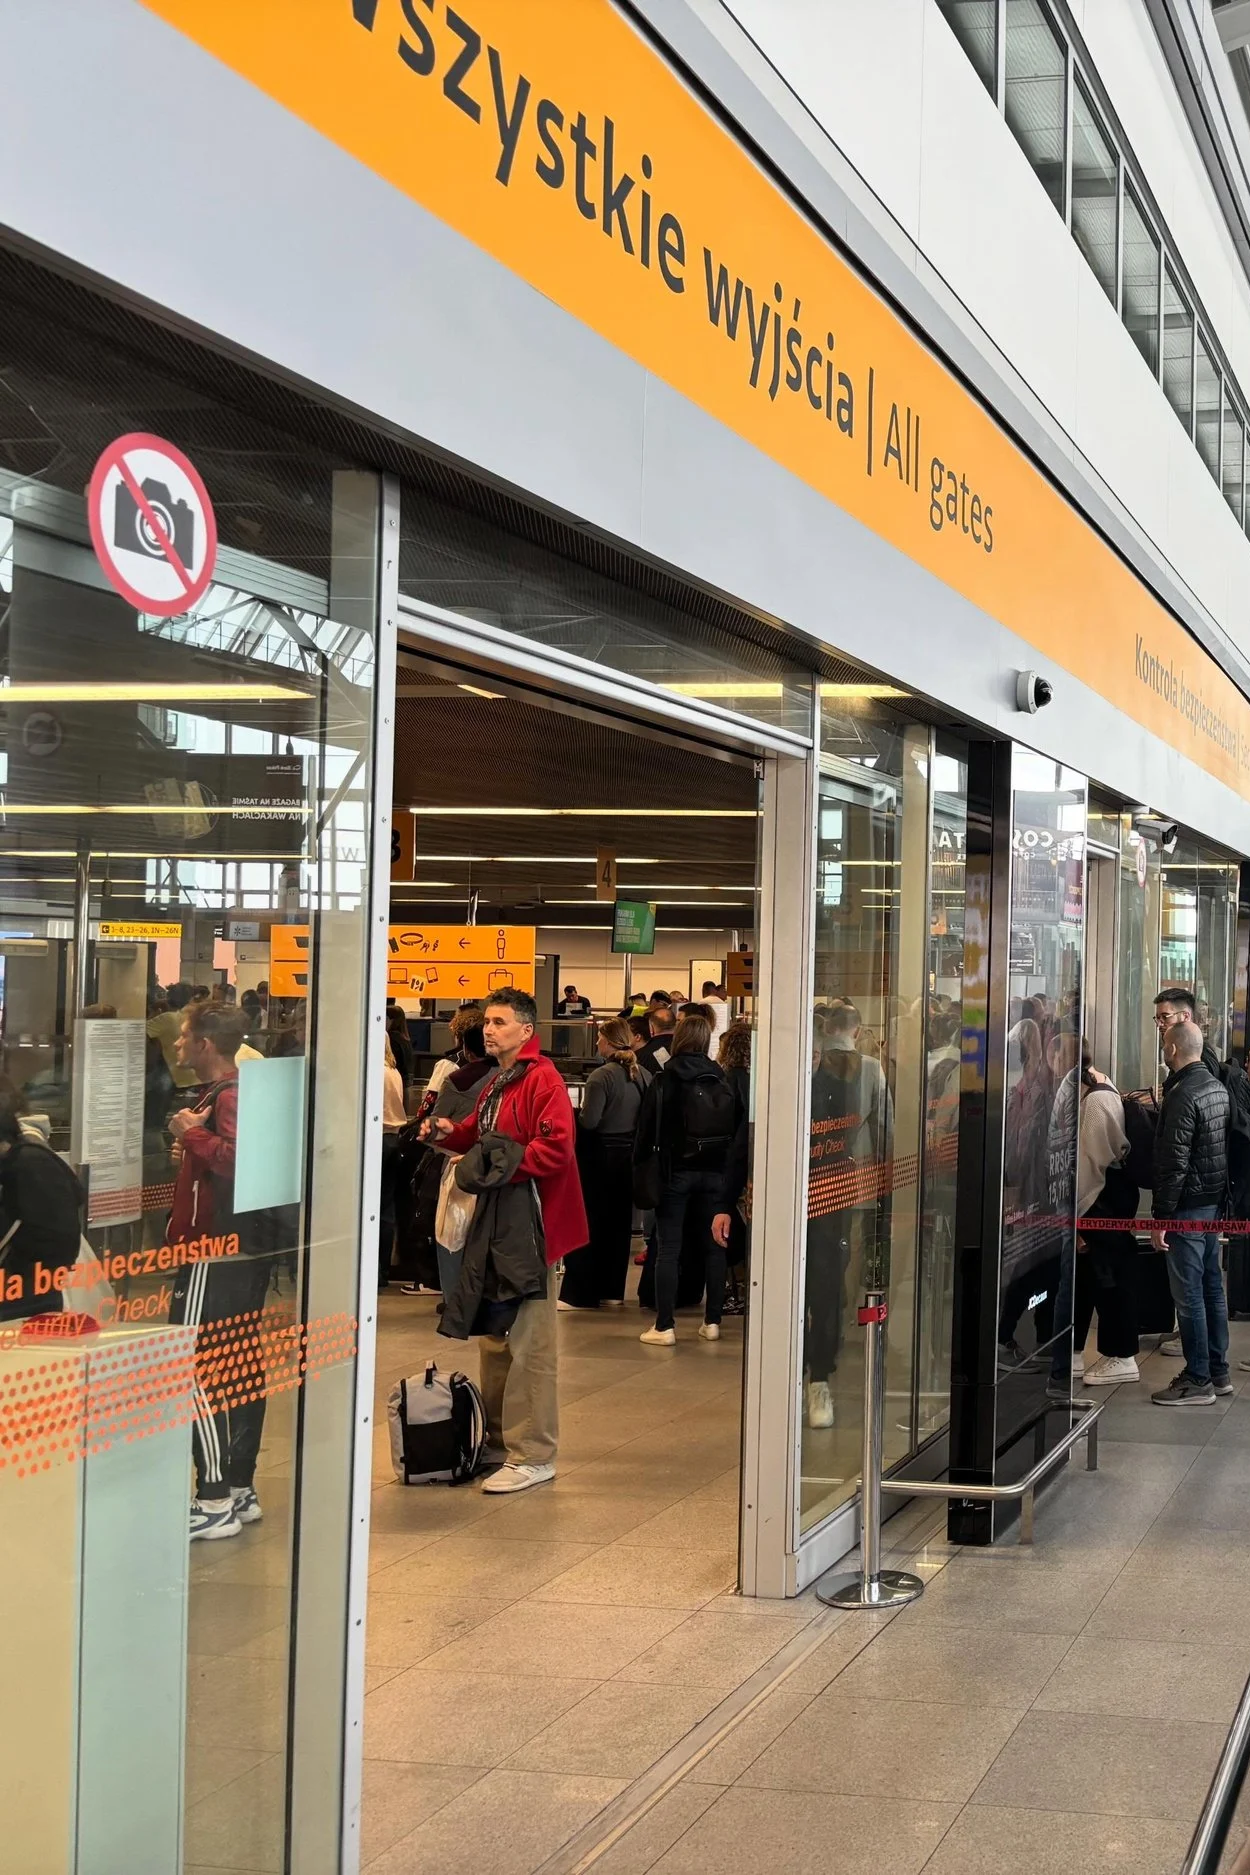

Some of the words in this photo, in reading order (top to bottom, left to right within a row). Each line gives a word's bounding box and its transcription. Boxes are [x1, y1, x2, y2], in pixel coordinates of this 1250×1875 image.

[703, 246, 854, 439] wyjścia
[883, 402, 920, 493] All
[929, 457, 993, 553] gates
[1135, 633, 1178, 709] Kontrola
[602, 860, 612, 888] 4
[1080, 1220, 1137, 1230] FRYDERYKA
[1140, 1220, 1185, 1230] CHOPINA
[1202, 1222, 1247, 1231] WARSAW
[34, 1232, 239, 1296] bezpieczeństwa
[97, 1285, 172, 1328] Check
